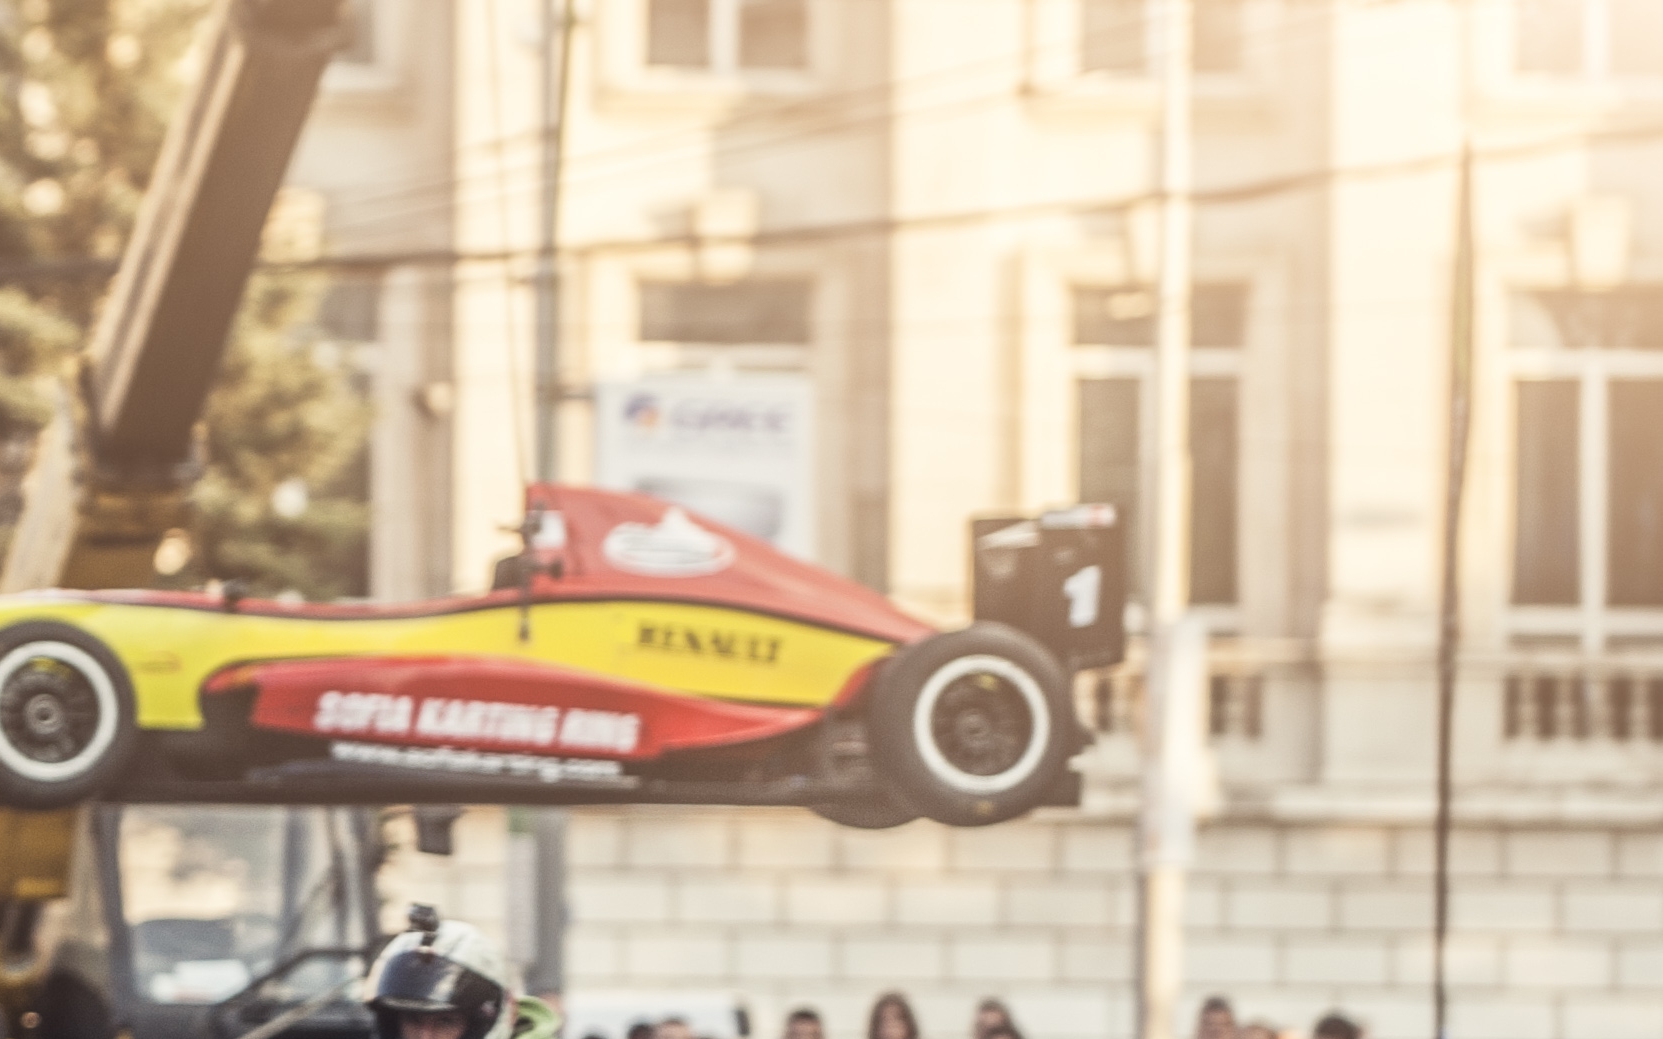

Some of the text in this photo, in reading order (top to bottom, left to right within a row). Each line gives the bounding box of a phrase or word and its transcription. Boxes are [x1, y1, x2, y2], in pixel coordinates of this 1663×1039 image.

[1062, 564, 1103, 619] 1
[638, 625, 782, 662] RENAULT
[314, 690, 642, 754] SOFIA KARTING RING
